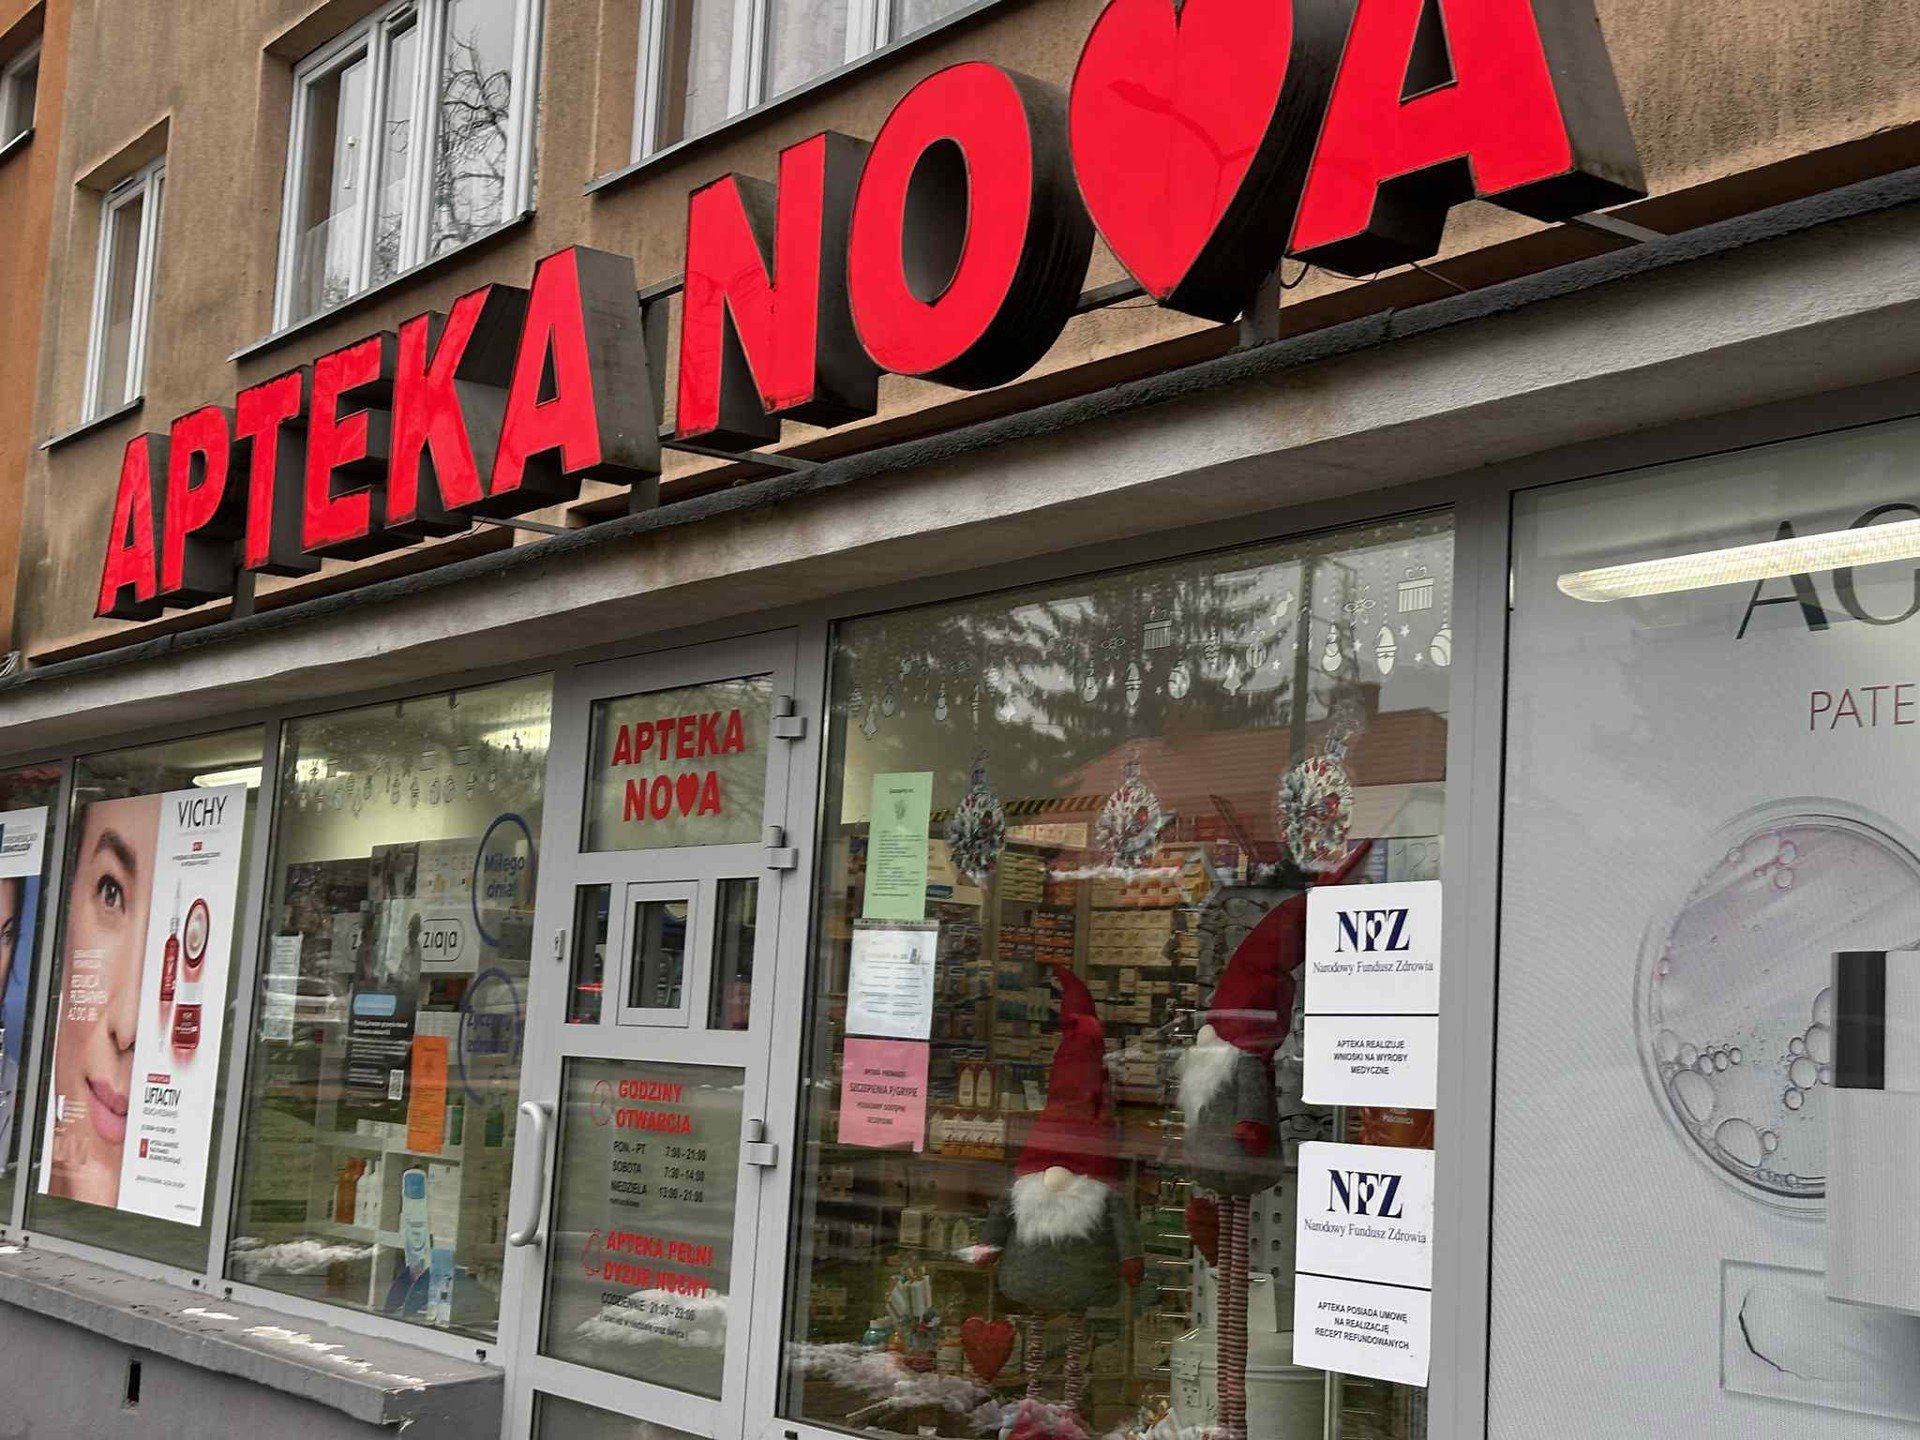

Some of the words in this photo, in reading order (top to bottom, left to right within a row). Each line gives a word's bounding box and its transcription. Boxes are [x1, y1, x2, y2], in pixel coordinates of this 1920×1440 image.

[94, 244, 603, 618] APTEKA
[1810, 684, 1915, 731] PATE
[611, 709, 745, 766] APTEKA
[178, 795, 228, 828] VICHY
[1335, 908, 1411, 953] NFZ
[1313, 961, 1353, 975] Narodowy
[1356, 960, 1394, 973] Fundusz
[1396, 959, 1434, 972] Zdrowia
[1336, 1040, 1364, 1049] APTEKA
[1366, 1040, 1405, 1049] REALIZUJE
[1364, 1053, 1375, 1062] NA
[1376, 1053, 1409, 1063] WYROBY
[1350, 1066, 1390, 1075] MEDYCZNE
[619, 1080, 683, 1102] GODZINY
[616, 1107, 691, 1134] OTWARCIA
[611, 1159, 642, 1174] SOBOTA
[1327, 1169, 1404, 1219] NFZ
[1304, 1218, 1346, 1237] Narodowy
[1348, 1224, 1387, 1239] Fundusz
[1387, 1228, 1427, 1244] Zdrowia
[606, 1229, 663, 1258] APTEKA
[1318, 1301, 1346, 1313] APTEKA
[1346, 1305, 1378, 1318] POSIADA
[1334, 1317, 1344, 1326] NA
[1315, 1327, 1343, 1340] RECEPT
[1344, 1331, 1409, 1350] REFUNDOWANYCH
